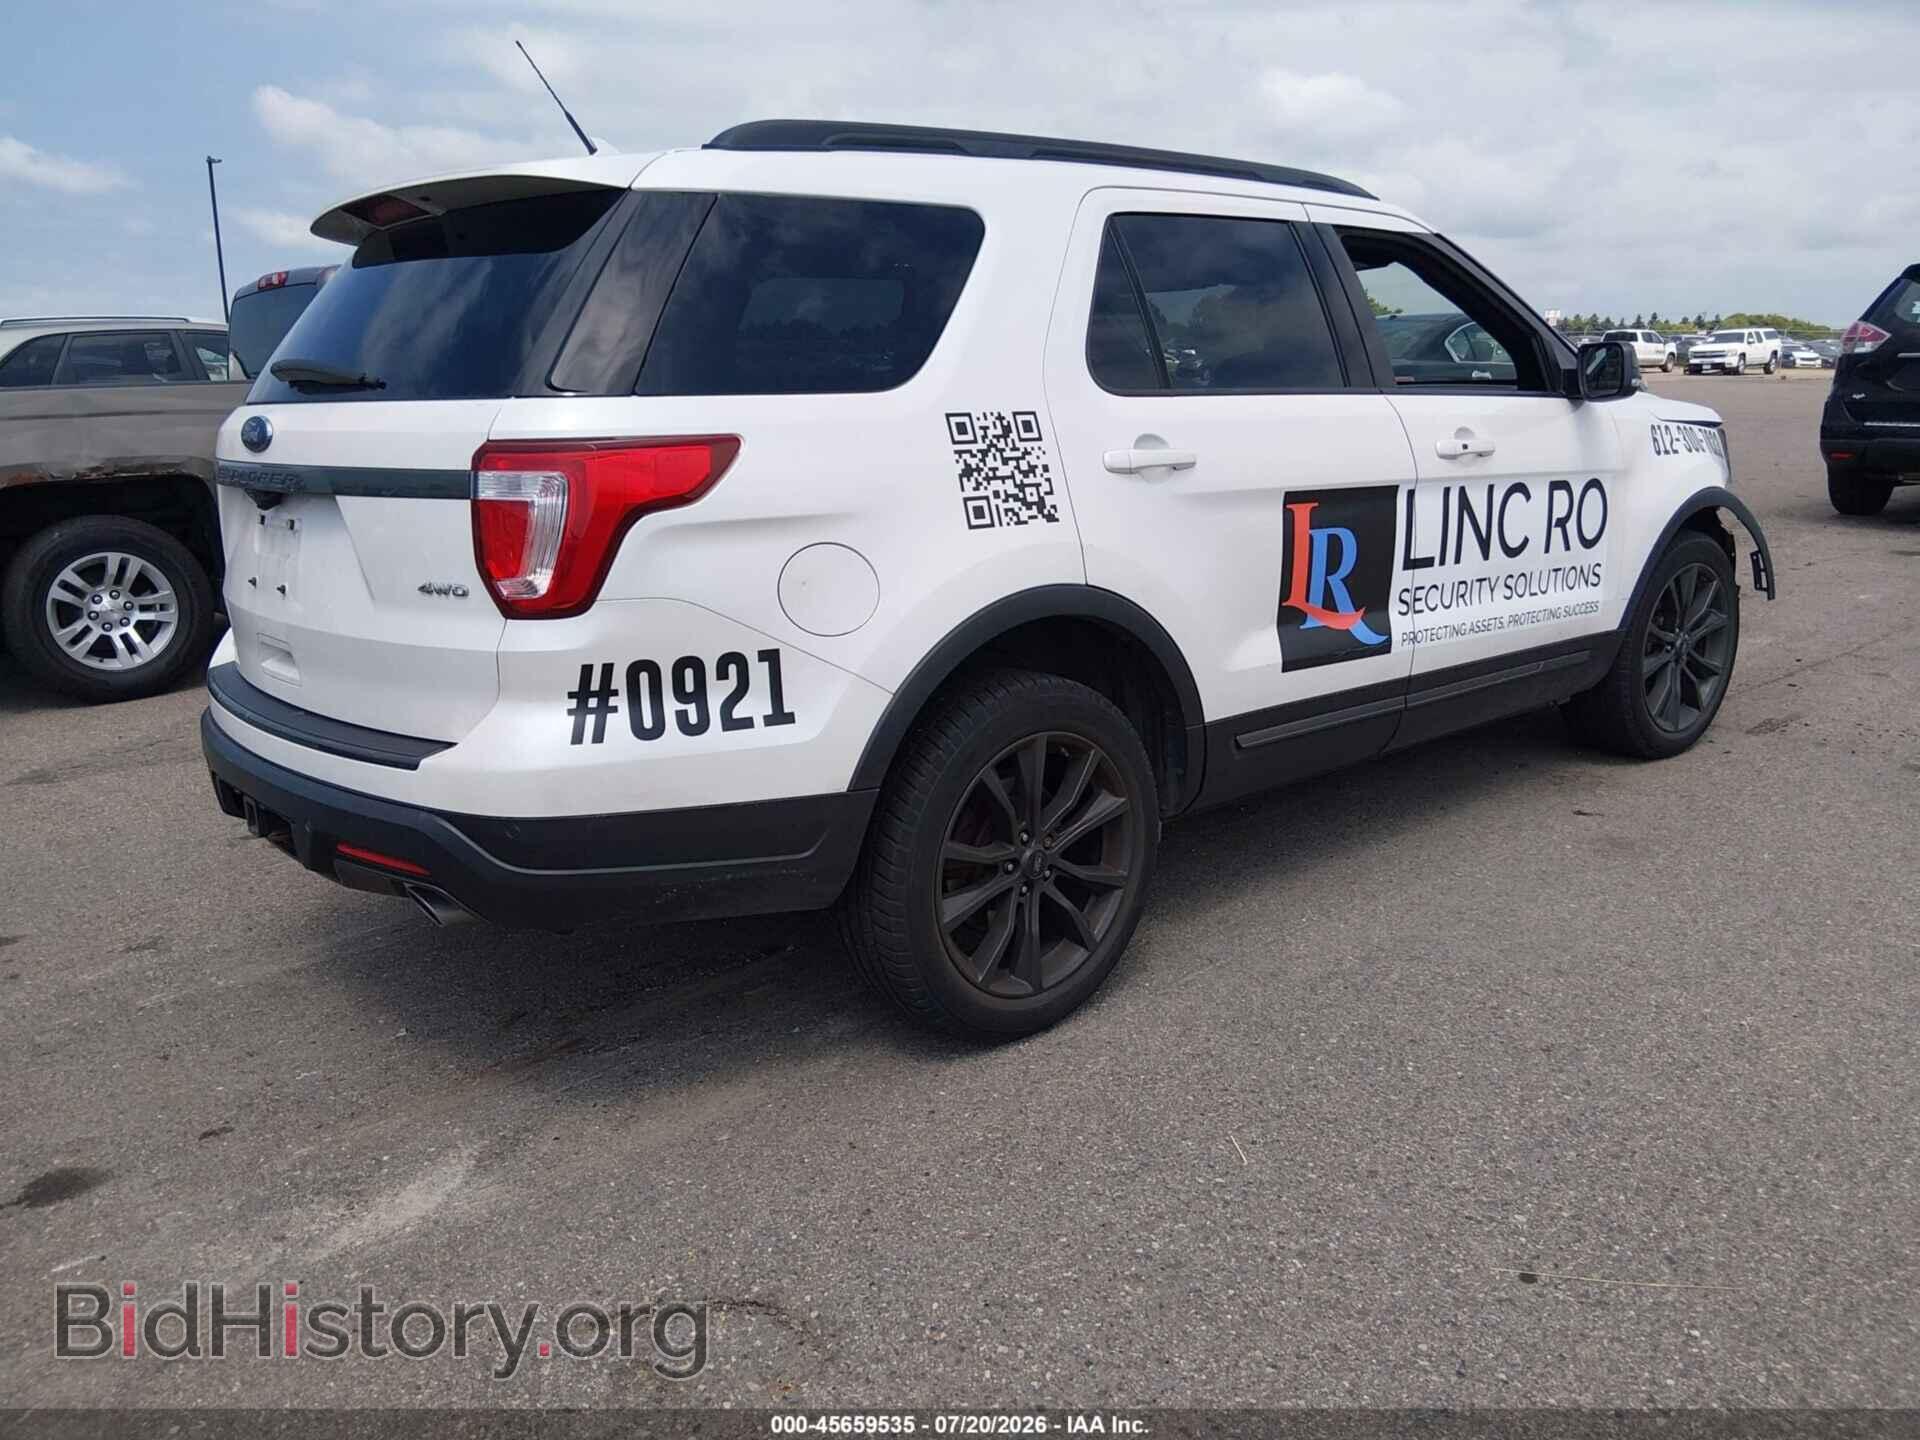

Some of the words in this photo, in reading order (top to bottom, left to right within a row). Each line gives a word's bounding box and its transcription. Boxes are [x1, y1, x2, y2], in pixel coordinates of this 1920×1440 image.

[1402, 482, 1531, 572] LINC
[1544, 477, 1608, 554] RO
[1398, 576, 1500, 616] SECURITY
[1503, 562, 1602, 600] SOLUTIONS
[1401, 623, 1467, 647] PROTECTING
[1508, 607, 1563, 627] PROTECTING
[1563, 600, 1600, 617] SUCCESS
[567, 648, 796, 746] #0921
